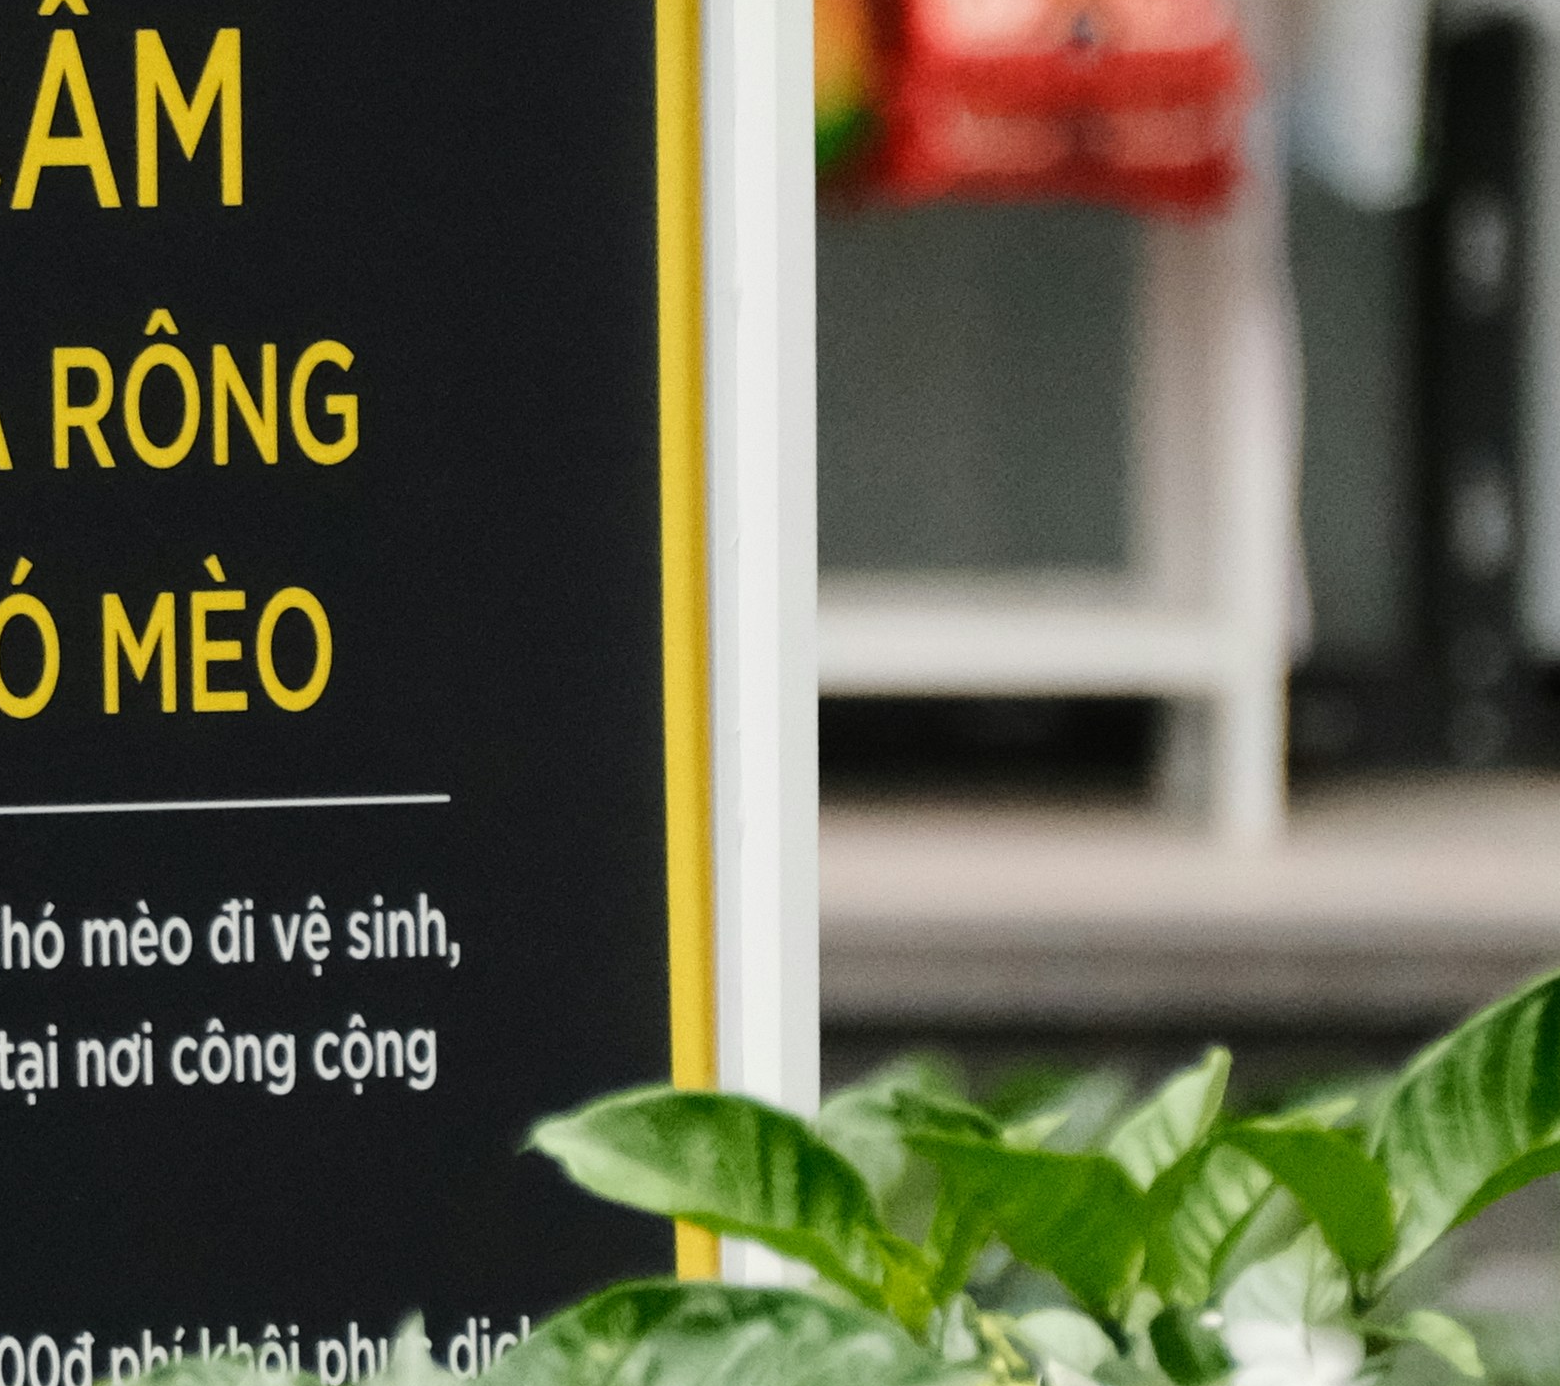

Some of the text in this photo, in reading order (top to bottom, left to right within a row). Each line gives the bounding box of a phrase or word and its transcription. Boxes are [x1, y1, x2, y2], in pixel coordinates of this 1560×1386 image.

[52, 309, 358, 469] RÔNG
[102, 555, 332, 714] MÈO
[82, 900, 192, 967] mèo
[209, 899, 254, 964] đi
[272, 895, 331, 976] vệ
[348, 893, 460, 967] sinh,
[77, 1022, 153, 1087] nơi
[171, 1018, 296, 1095] công
[313, 1014, 437, 1095] cộng
